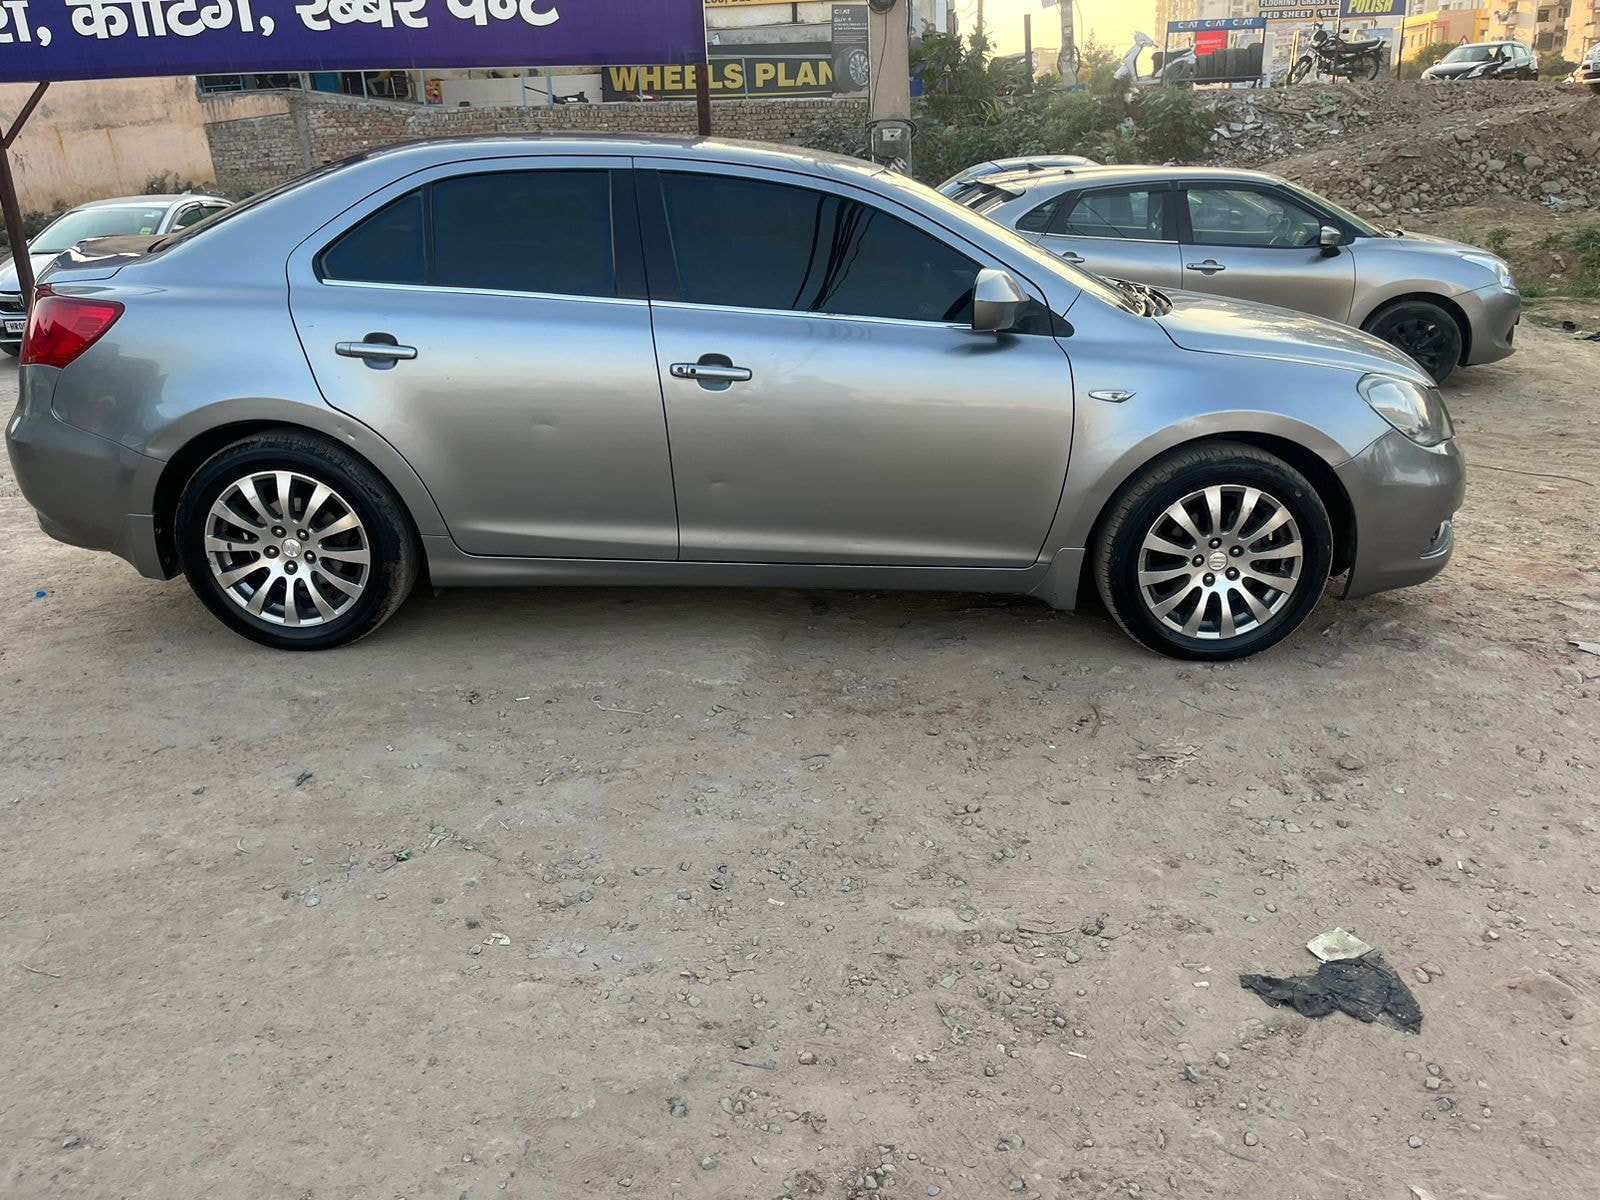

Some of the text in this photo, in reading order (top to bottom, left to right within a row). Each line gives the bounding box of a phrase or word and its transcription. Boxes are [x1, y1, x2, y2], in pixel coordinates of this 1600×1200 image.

[1346, 0, 1394, 13] POLISH
[1281, 10, 1313, 18] SHEET
[609, 64, 744, 91] WHEELS
